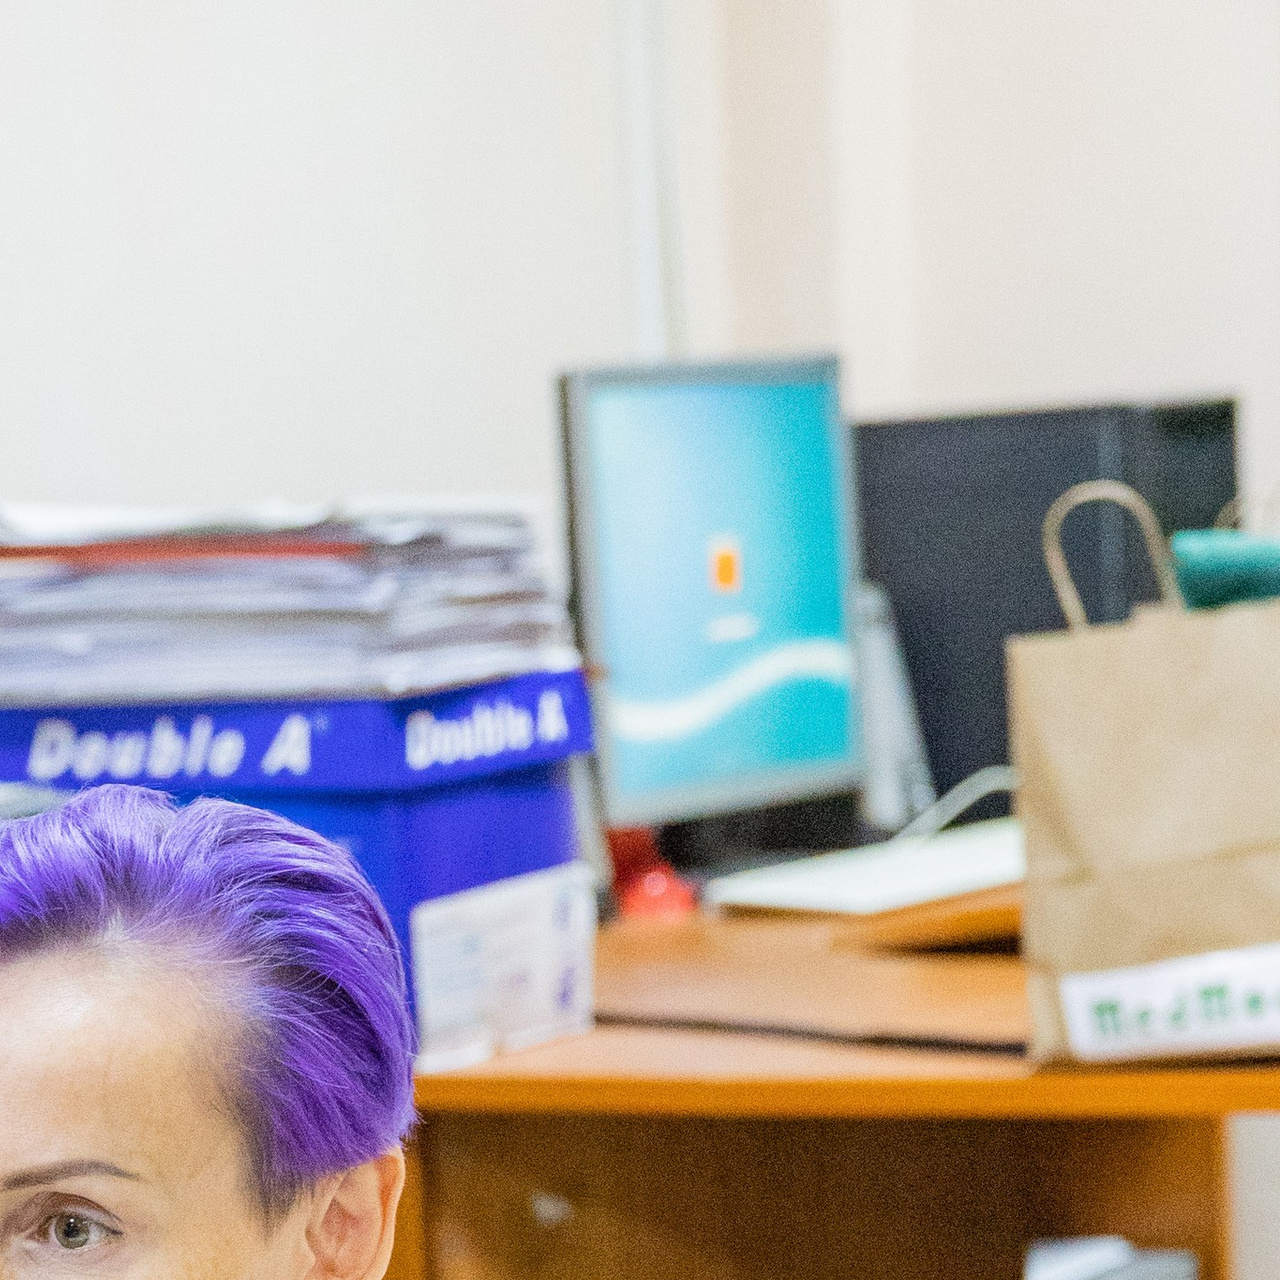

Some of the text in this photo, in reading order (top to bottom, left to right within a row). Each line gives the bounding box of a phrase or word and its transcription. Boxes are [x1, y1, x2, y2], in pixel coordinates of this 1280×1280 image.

[27, 713, 313, 779] Double A
[406, 702, 532, 770] Double
